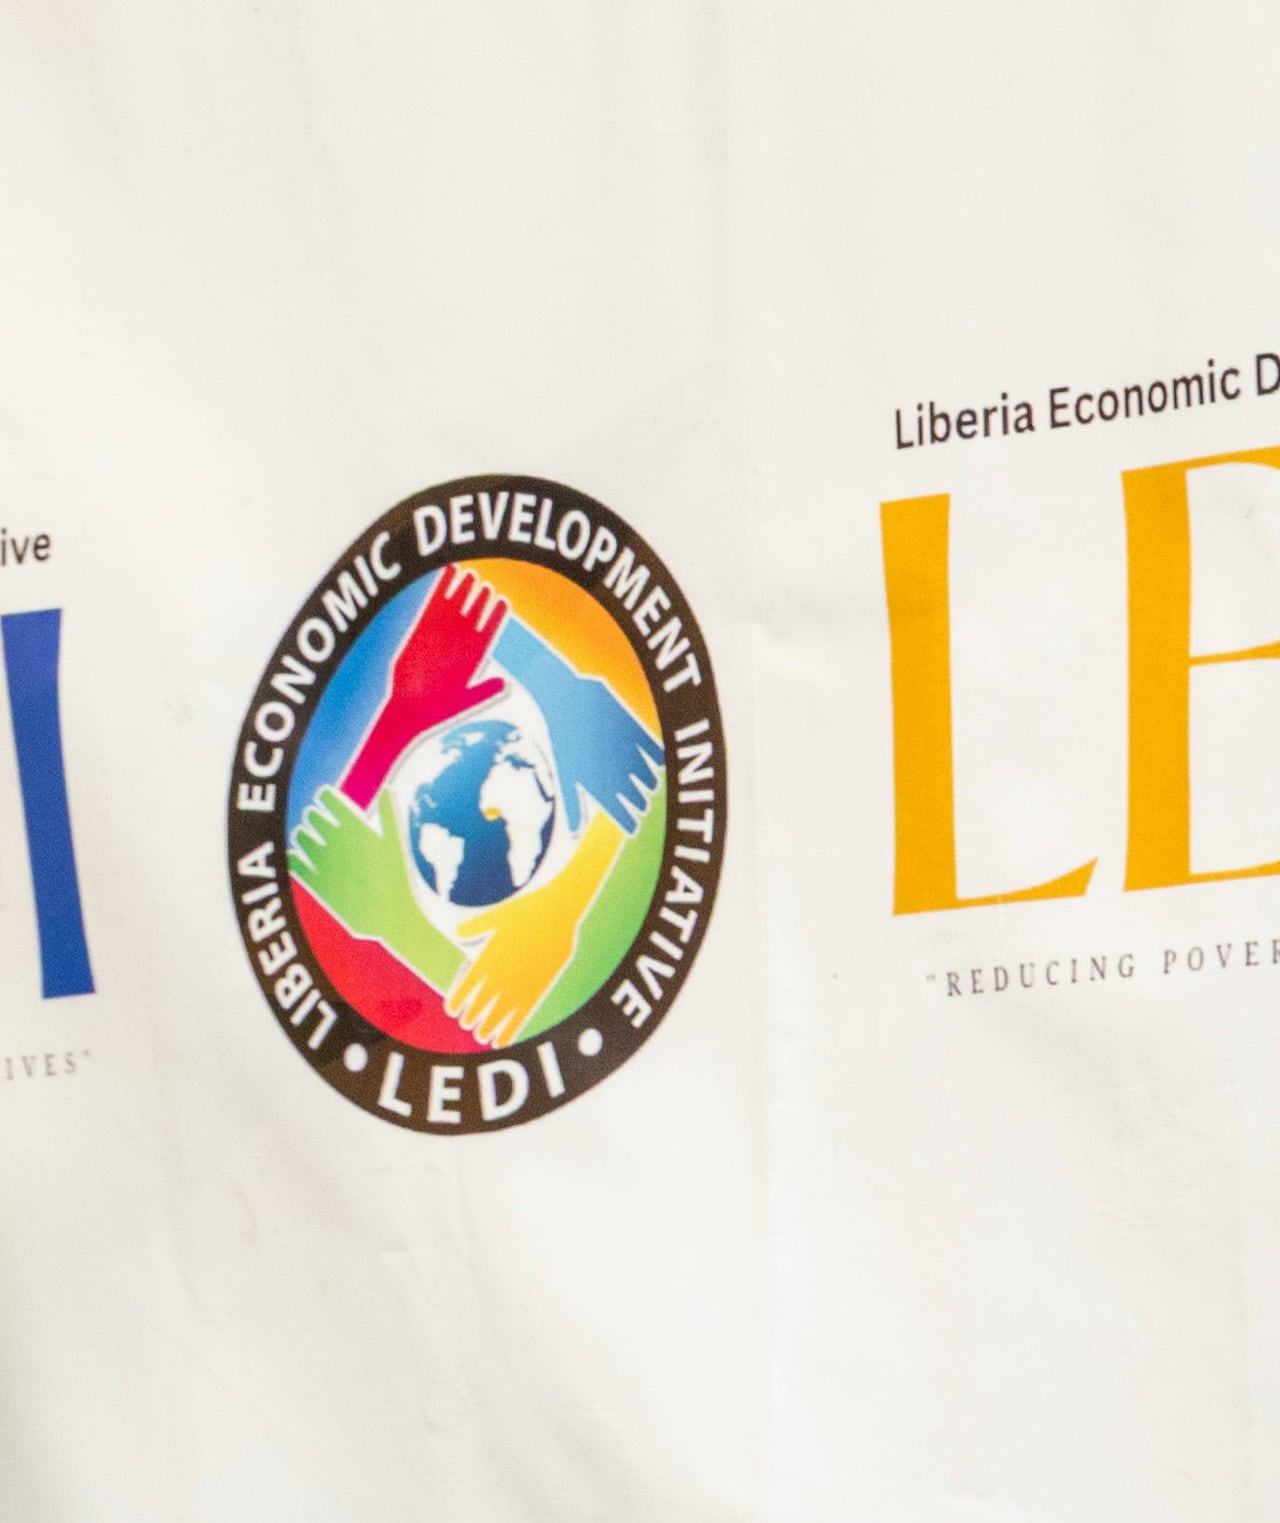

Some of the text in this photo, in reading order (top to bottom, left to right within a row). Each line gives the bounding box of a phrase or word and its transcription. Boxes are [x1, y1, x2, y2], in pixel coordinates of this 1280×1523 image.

[895, 393, 1034, 450] Liberia
[1049, 359, 1241, 430] Economic
[238, 531, 403, 813] ECONOMIC
[412, 491, 702, 695] DEVELOPMENT
[236, 841, 339, 1051] LIBERIA
[611, 719, 713, 1029] INITIATIVE
[926, 954, 1134, 997] "REDUCING
[377, 1047, 567, 1124] LEDI
